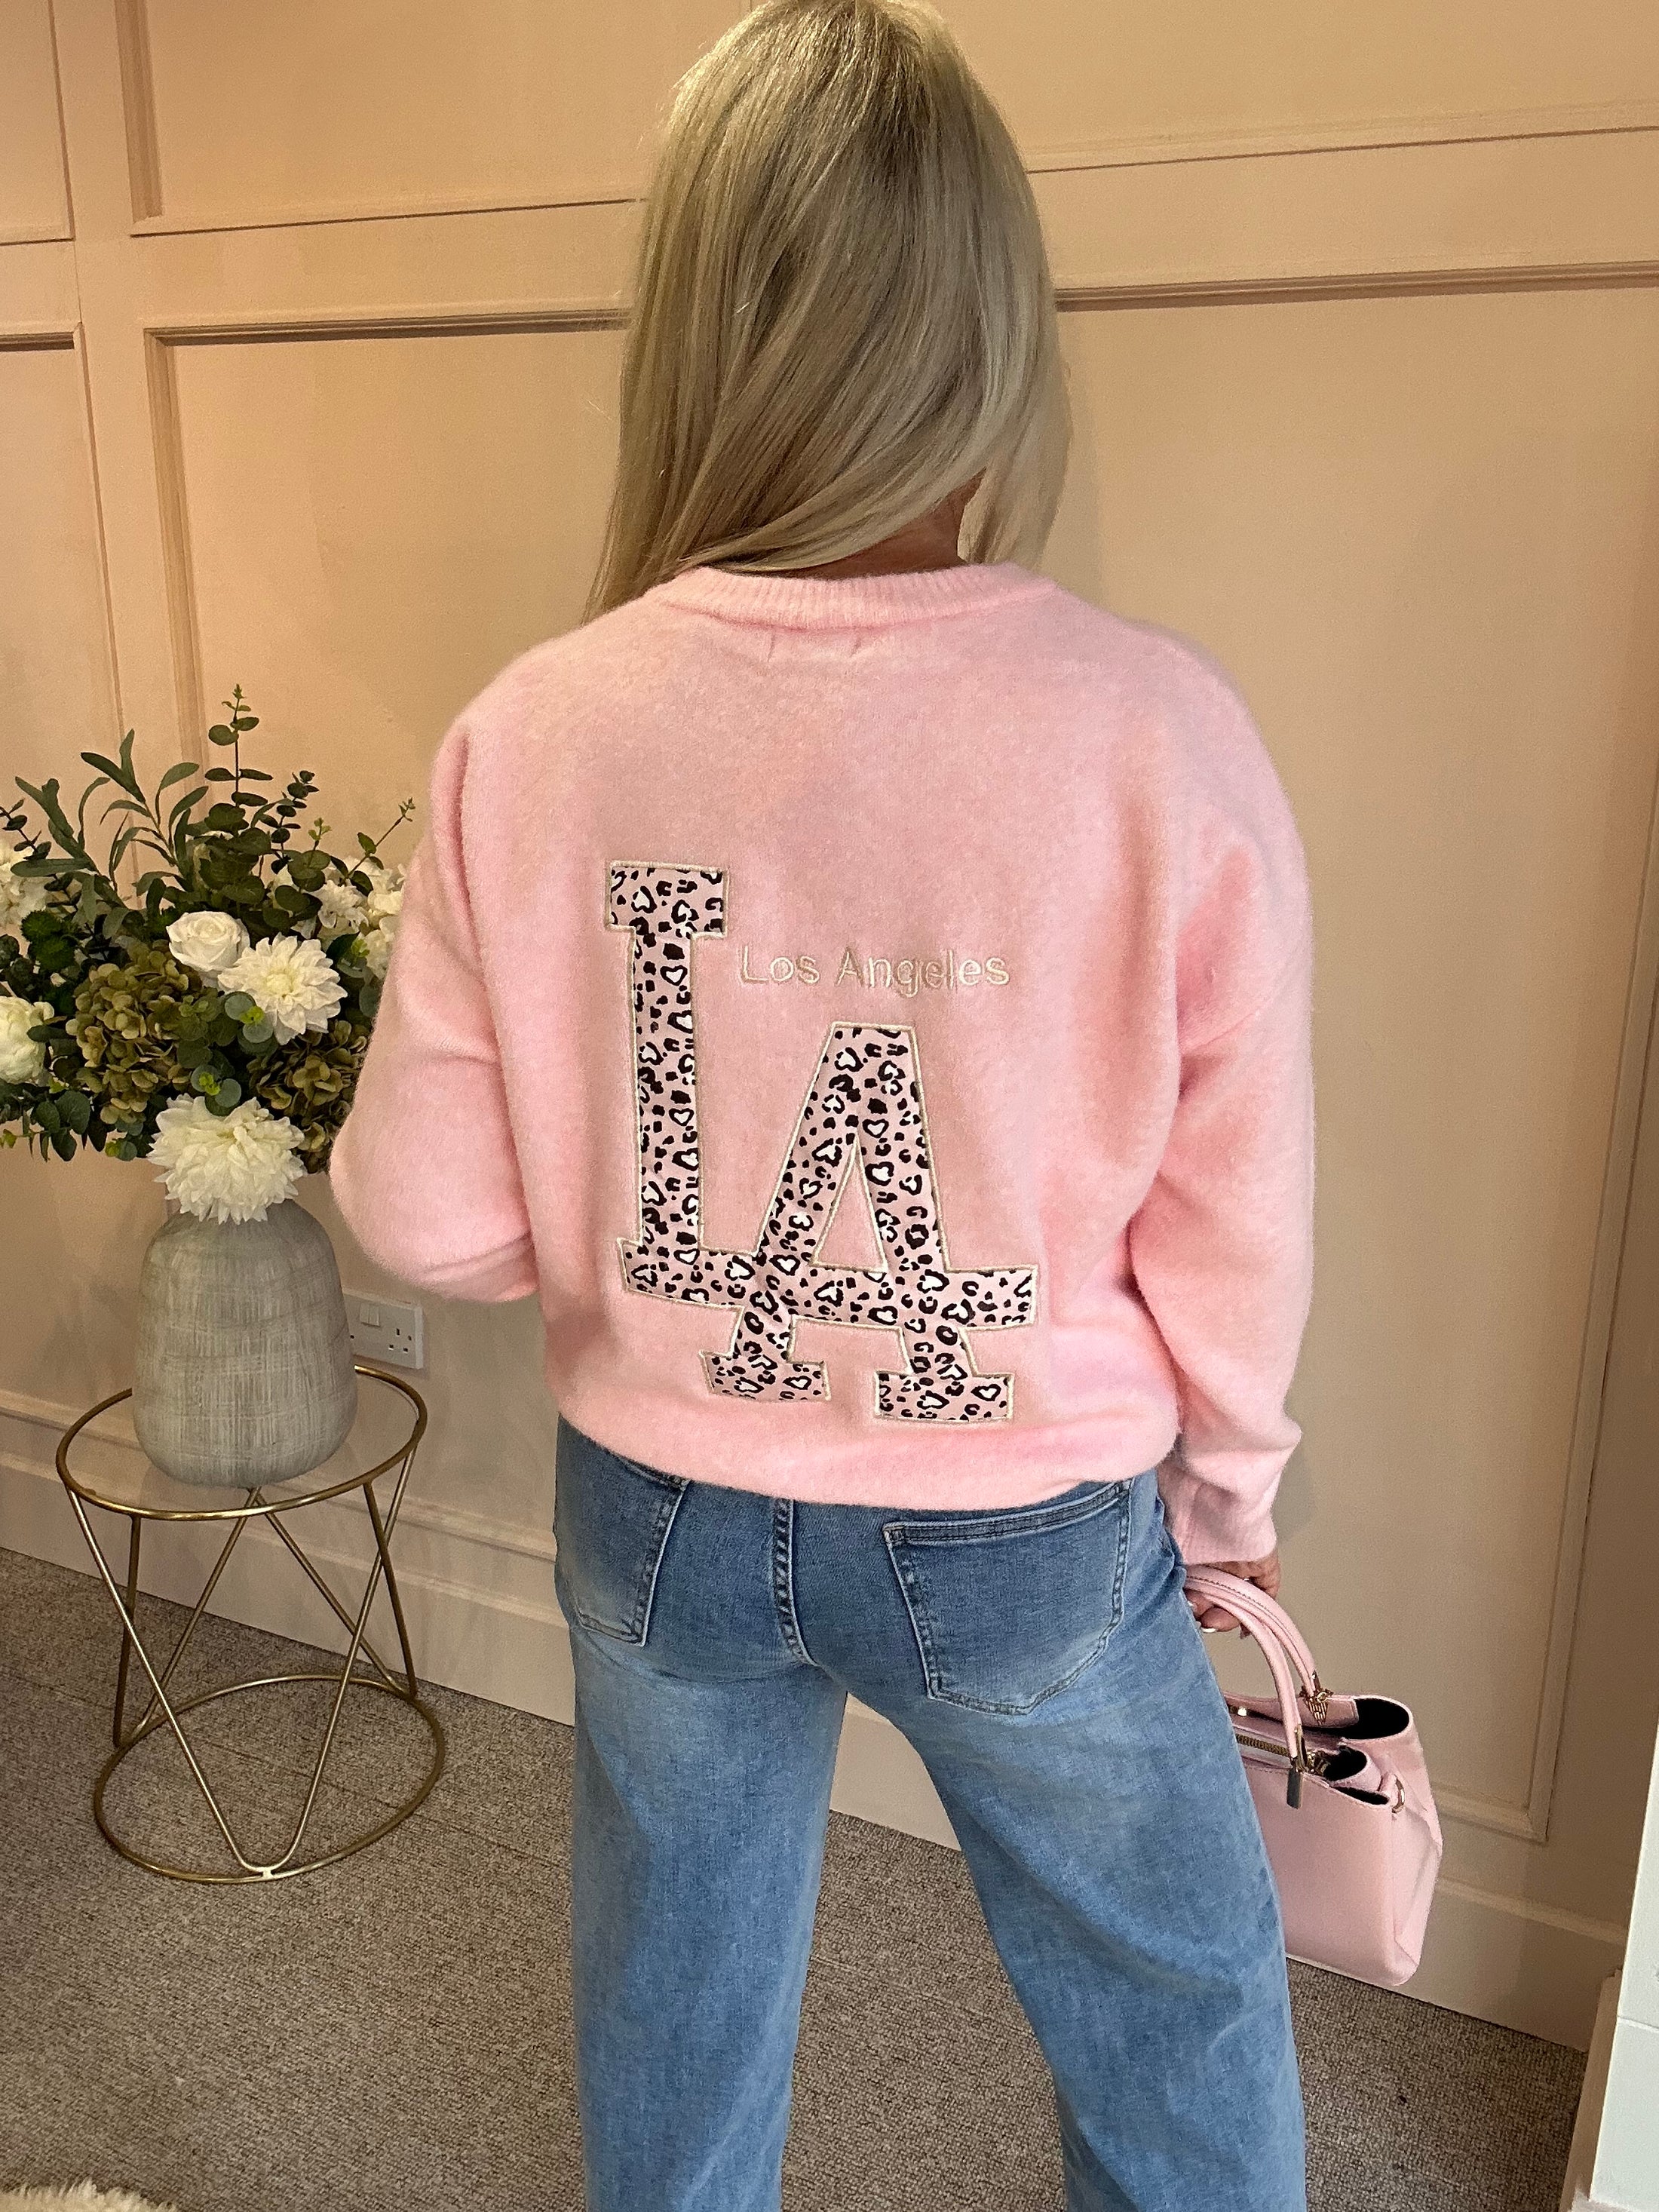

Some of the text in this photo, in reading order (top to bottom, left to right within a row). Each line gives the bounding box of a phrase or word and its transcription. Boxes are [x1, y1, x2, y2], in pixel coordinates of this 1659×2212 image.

[741, 945, 1010, 998] Los Angeles
[604, 861, 1038, 1422] LA
